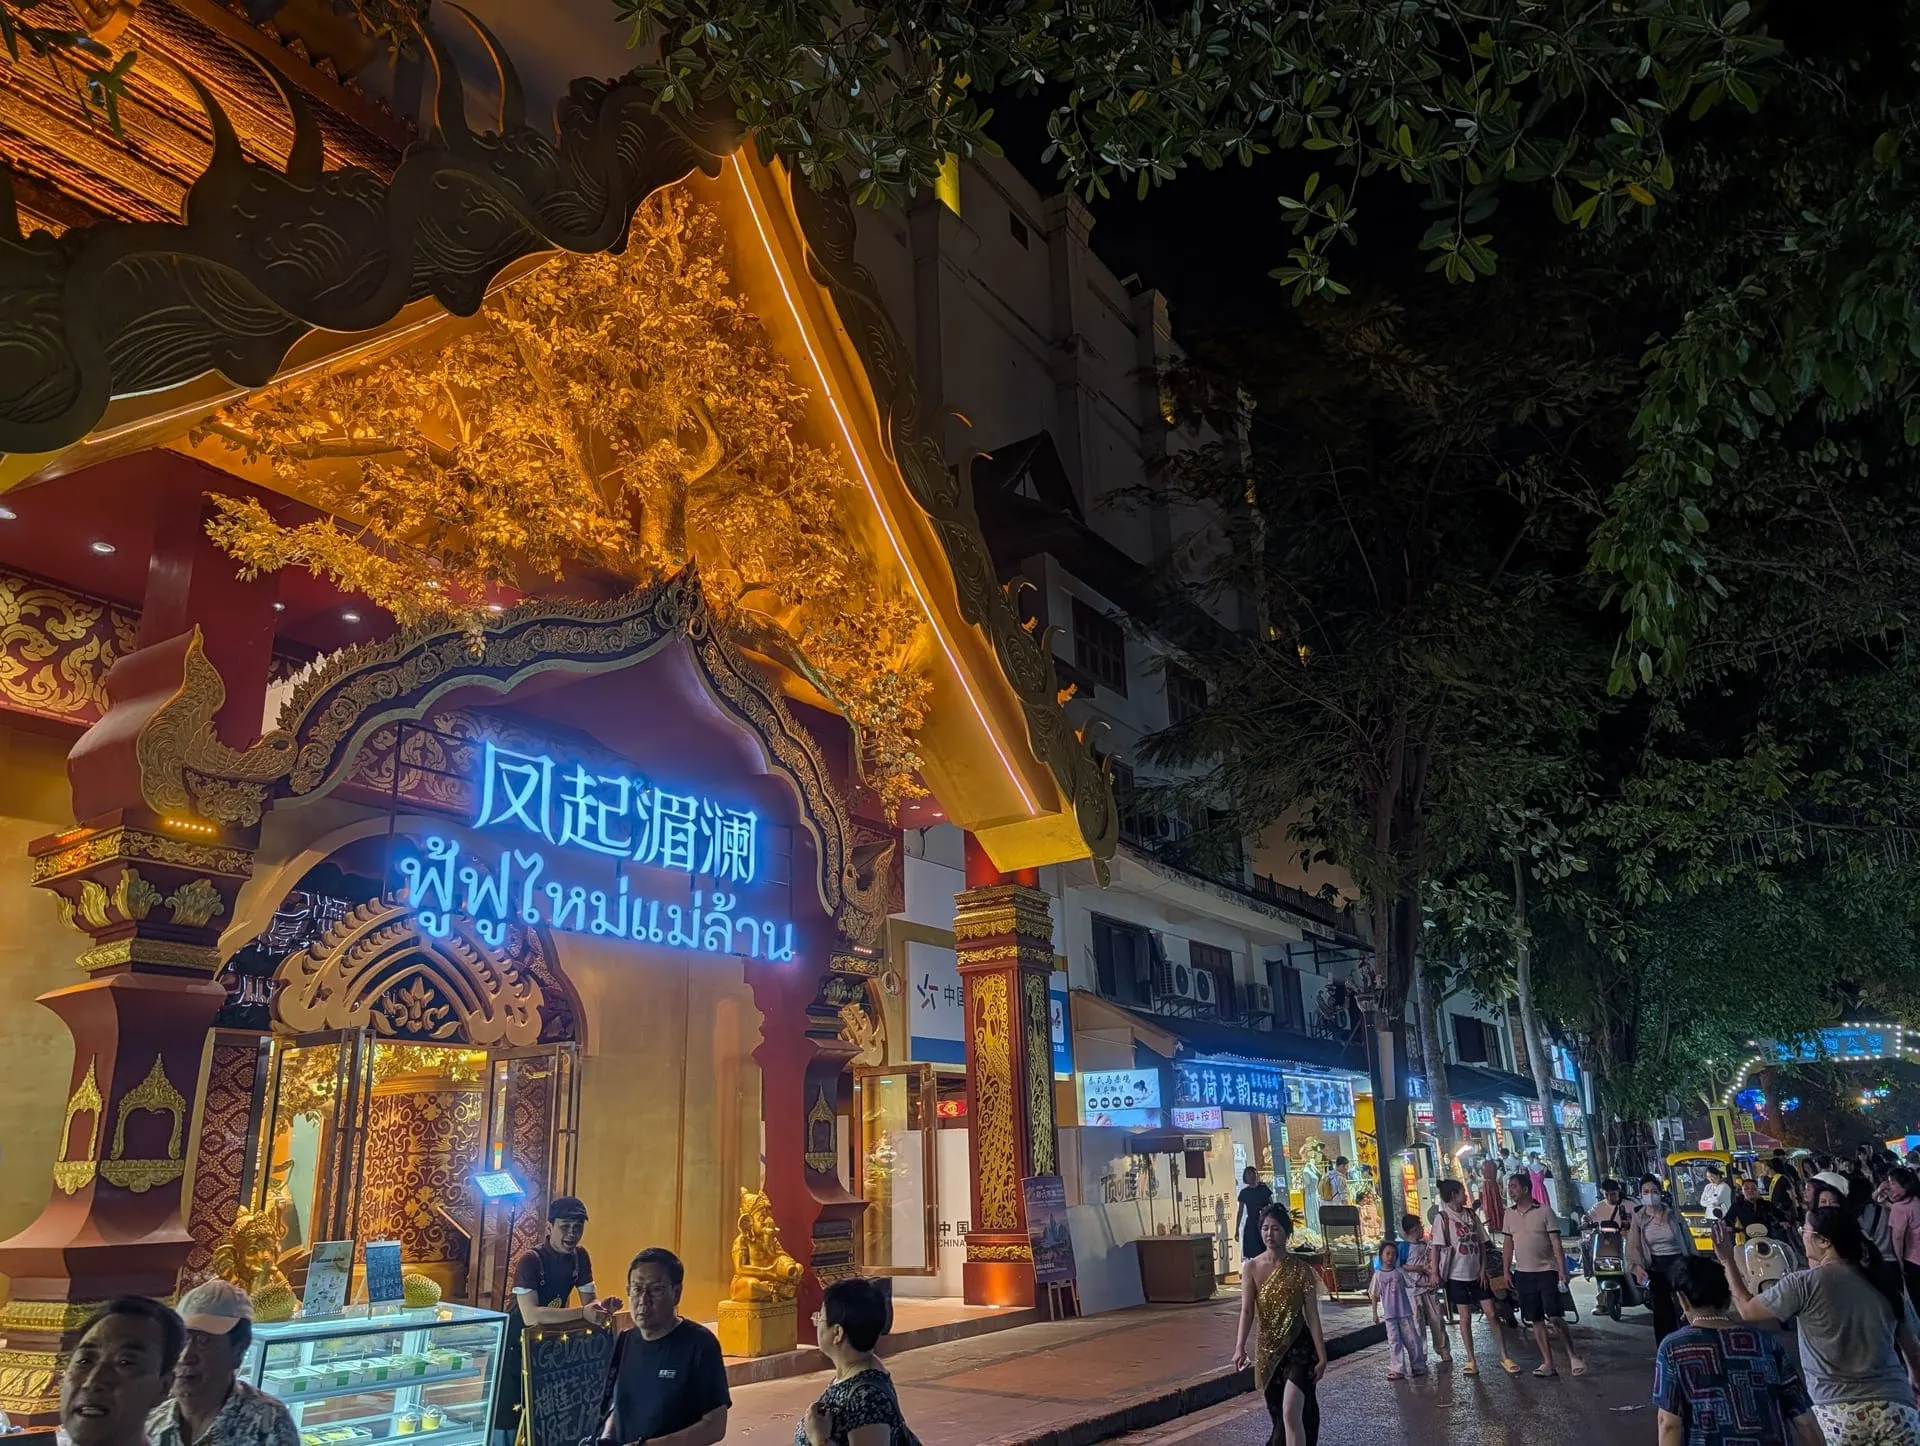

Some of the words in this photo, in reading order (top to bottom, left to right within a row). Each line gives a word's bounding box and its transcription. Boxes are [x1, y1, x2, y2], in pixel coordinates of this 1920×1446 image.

[471, 740, 759, 884] 凤起湄澜
[1184, 1192, 1231, 1212] 中国体育票
[939, 1221, 969, 1236] 中国
